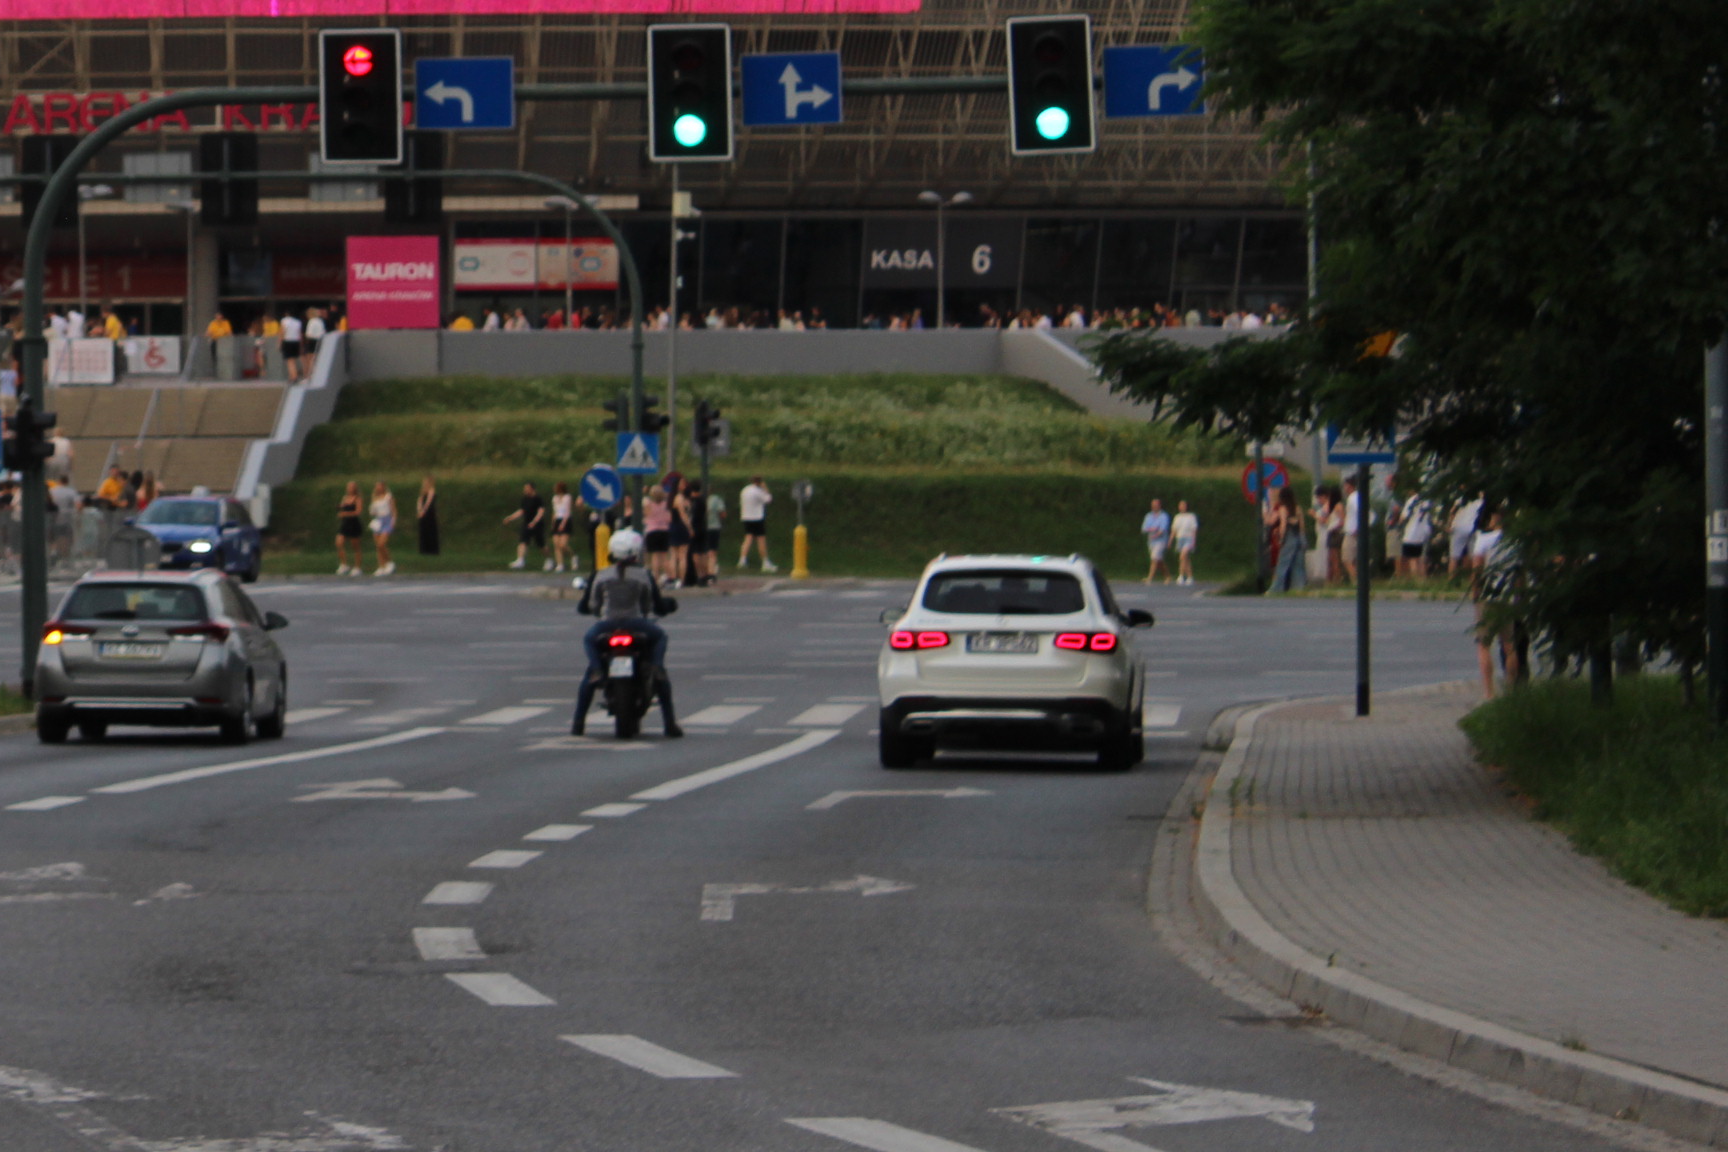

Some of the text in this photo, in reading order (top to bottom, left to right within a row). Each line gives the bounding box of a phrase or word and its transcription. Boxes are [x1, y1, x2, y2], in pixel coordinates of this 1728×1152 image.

[352, 261, 435, 281] TAURON
[870, 244, 992, 275] KASA 6
[118, 264, 132, 292] 1
